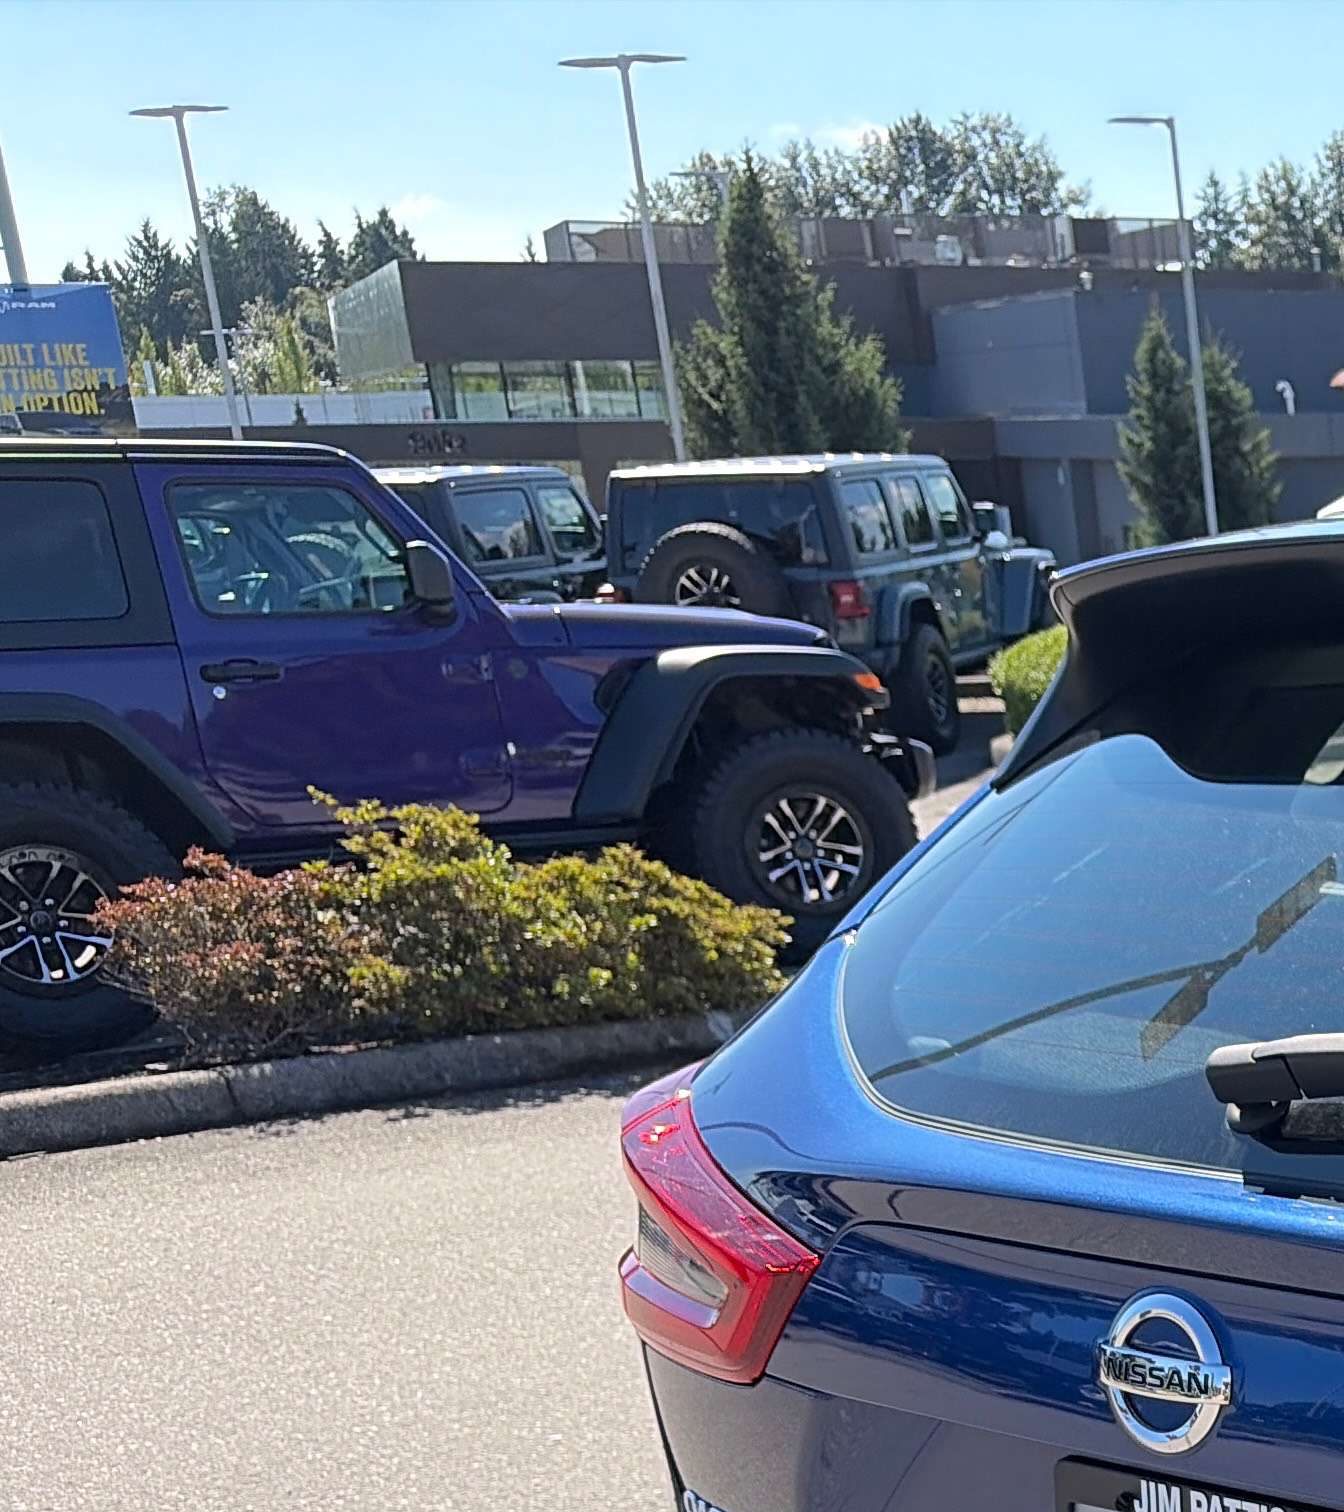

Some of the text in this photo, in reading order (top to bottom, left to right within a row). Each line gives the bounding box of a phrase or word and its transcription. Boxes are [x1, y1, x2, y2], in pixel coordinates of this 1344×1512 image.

[41, 344, 90, 366] LIKE
[62, 368, 116, 390] ISN'T
[1106, 1357, 1210, 1395] NISSAN
